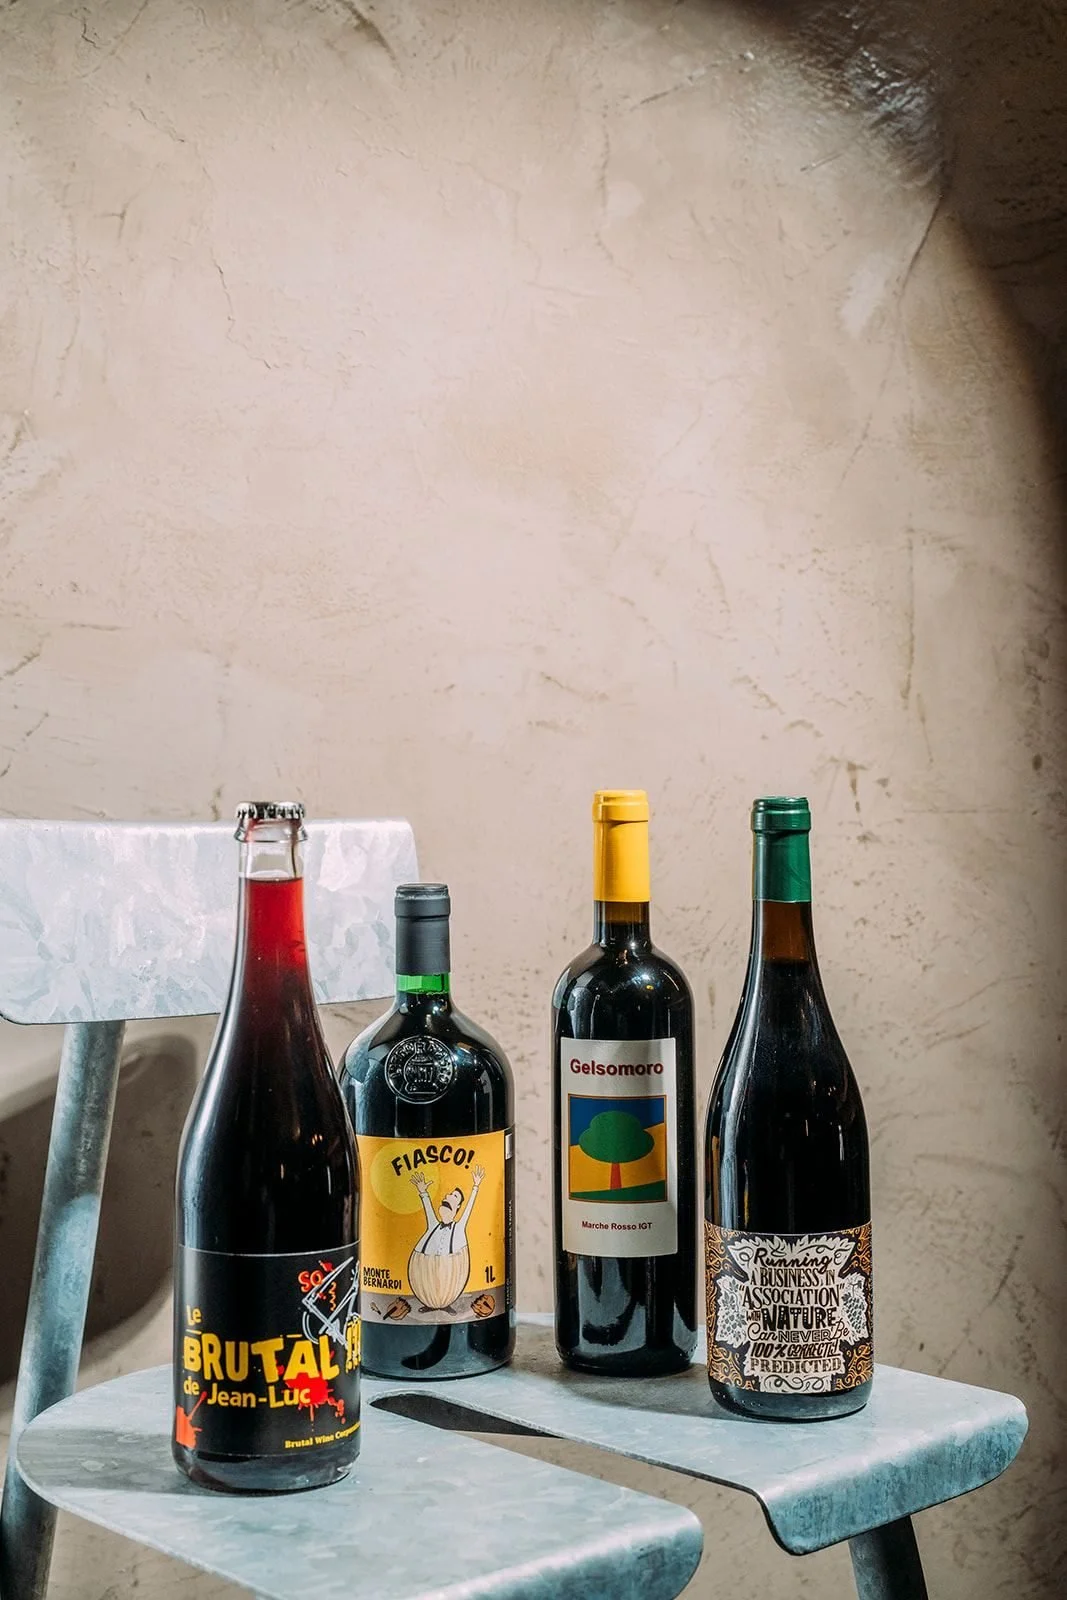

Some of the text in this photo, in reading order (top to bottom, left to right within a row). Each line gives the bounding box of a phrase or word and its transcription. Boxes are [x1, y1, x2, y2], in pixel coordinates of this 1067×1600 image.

[570, 1058, 665, 1077] Gelsomoro
[391, 1144, 475, 1176] FIASCO!
[581, 1220, 653, 1230] Marche Rosso IGT
[754, 1248, 832, 1274] Running
[363, 1266, 391, 1280] MONTE
[484, 1265, 496, 1284] 1L
[751, 1266, 835, 1288] A BUSINESS IN
[363, 1276, 402, 1290] BERNARDI
[761, 1305, 837, 1331] NATURE
[747, 1318, 850, 1343] Can NEVER Be
[183, 1332, 341, 1383] BRUTAL
[750, 1341, 788, 1359] 100%
[750, 1357, 842, 1374] PREDICTED
[183, 1376, 200, 1396] de
[207, 1382, 311, 1408] Jean-Luc
[284, 1436, 314, 1449] Brutal
[314, 1433, 335, 1444] Wine
